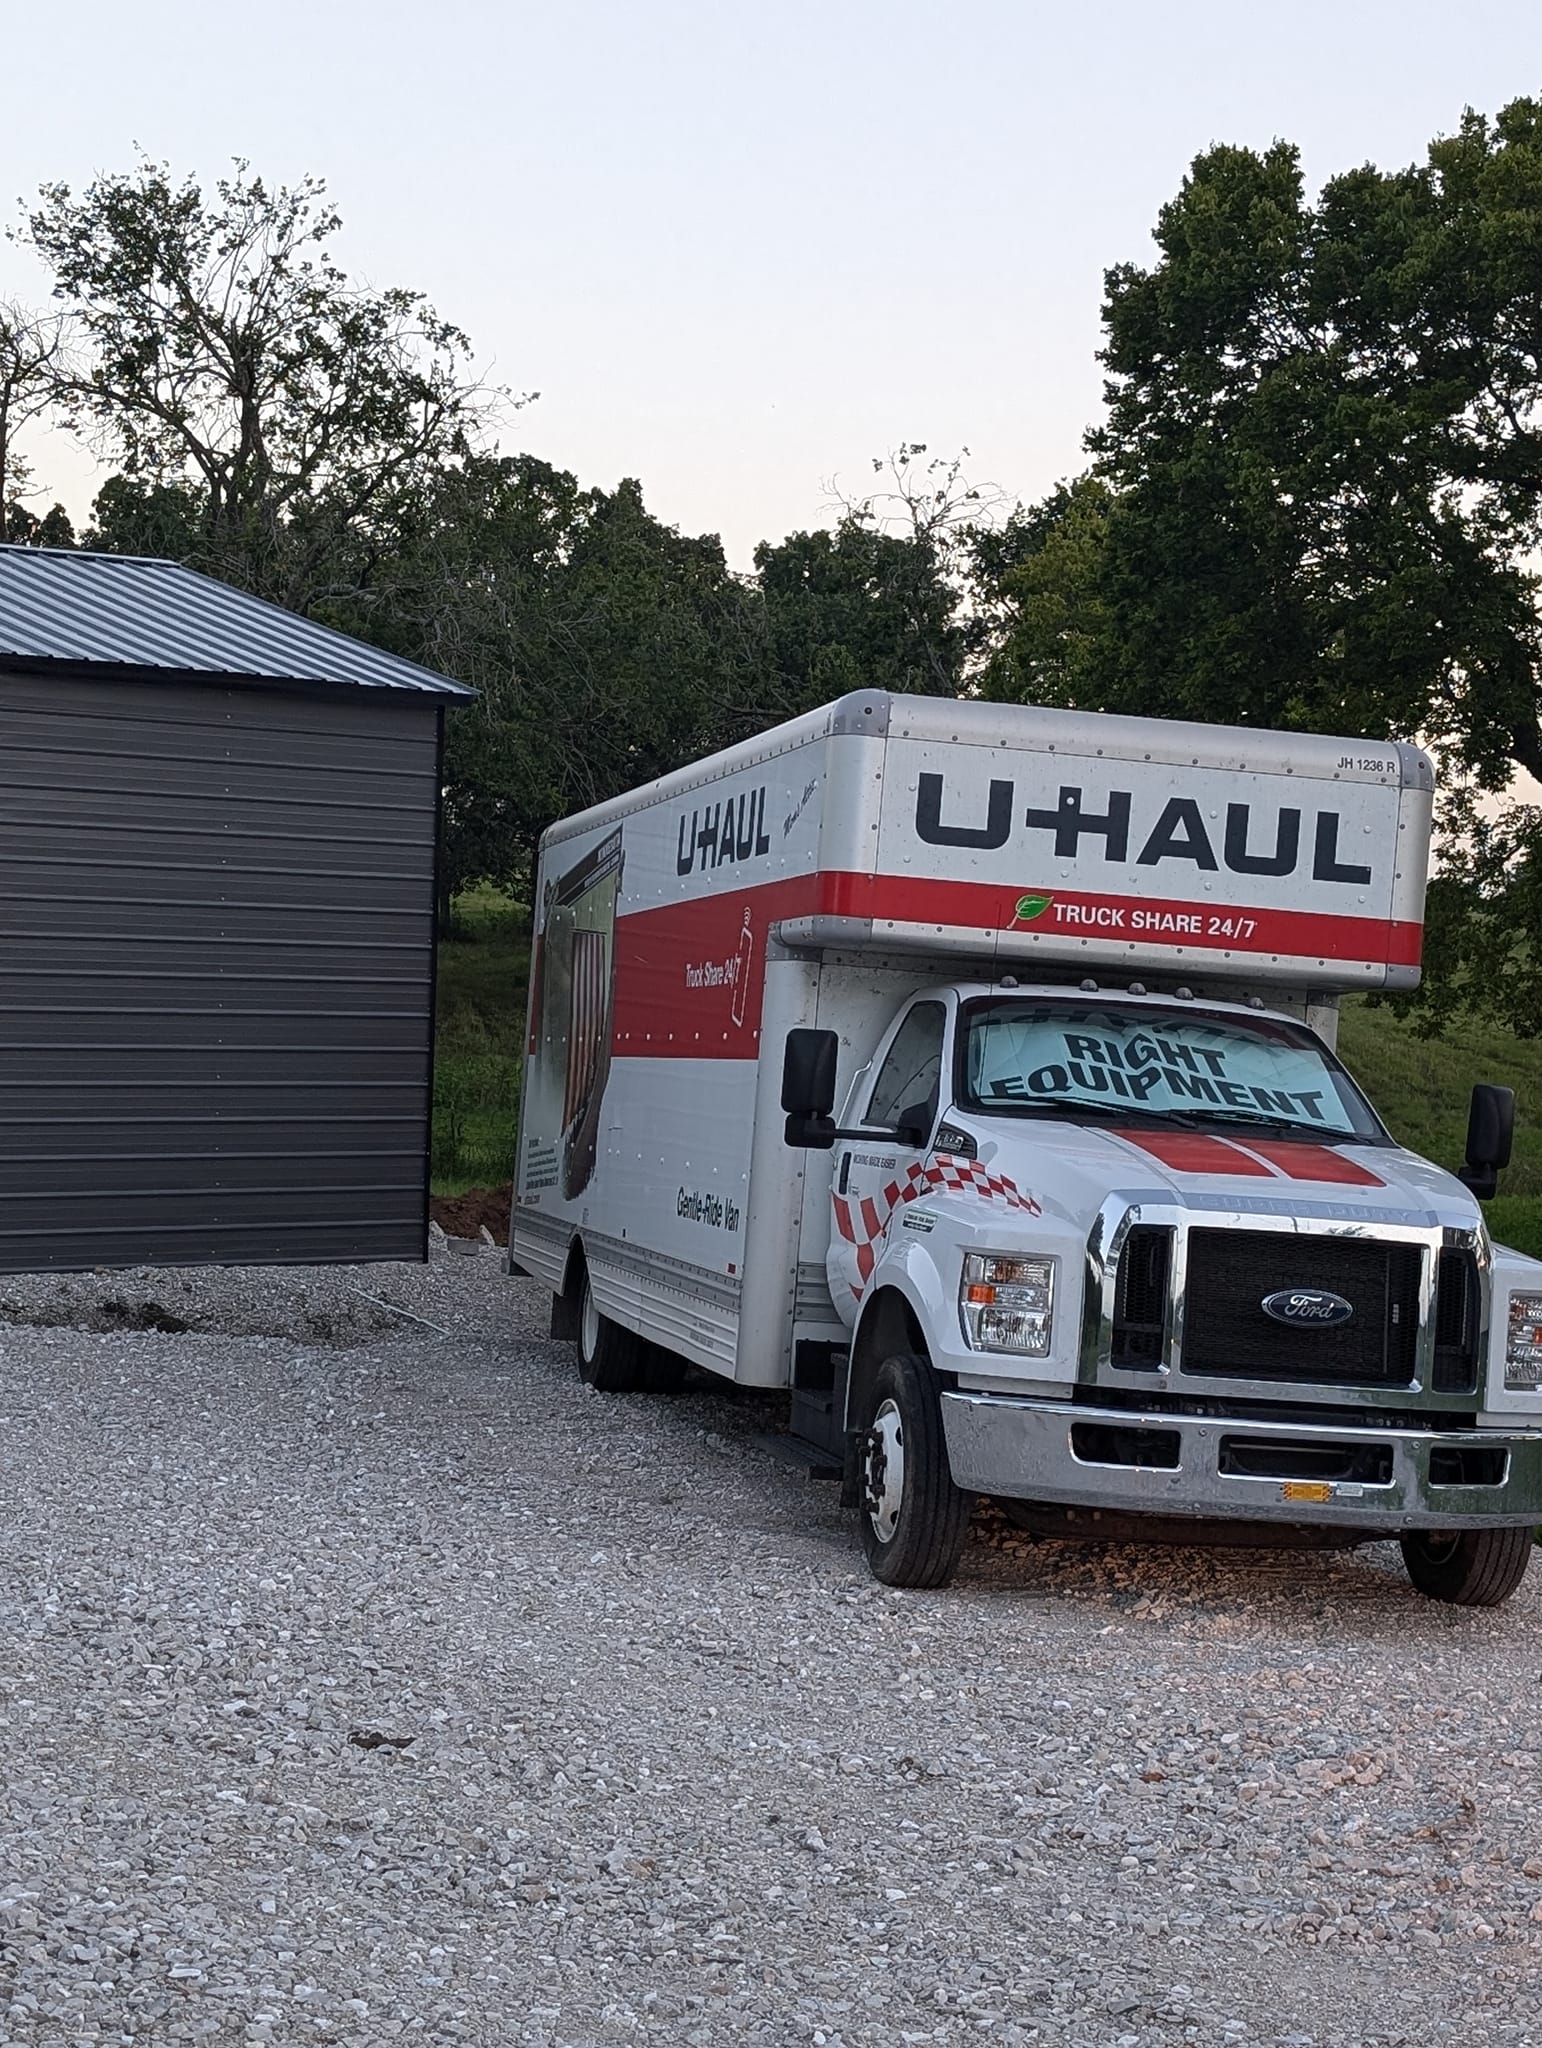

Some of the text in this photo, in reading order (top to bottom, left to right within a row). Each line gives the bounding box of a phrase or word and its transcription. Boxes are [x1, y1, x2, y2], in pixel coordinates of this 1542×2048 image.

[1337, 756, 1396, 773] JH 1236 R
[677, 786, 770, 876] U-HAUL
[915, 772, 1371, 885] U-HAUL
[1053, 903, 1255, 938] TRUCK SHARE 24/7
[686, 963, 704, 987] Truck
[704, 961, 724, 987] Share
[1063, 1033, 1225, 1078] RIGHT
[989, 1061, 1325, 1120] EQUIPMENT
[677, 1186, 739, 1232] Gentle-Ride Van
[1284, 1294, 1335, 1318] Ford
